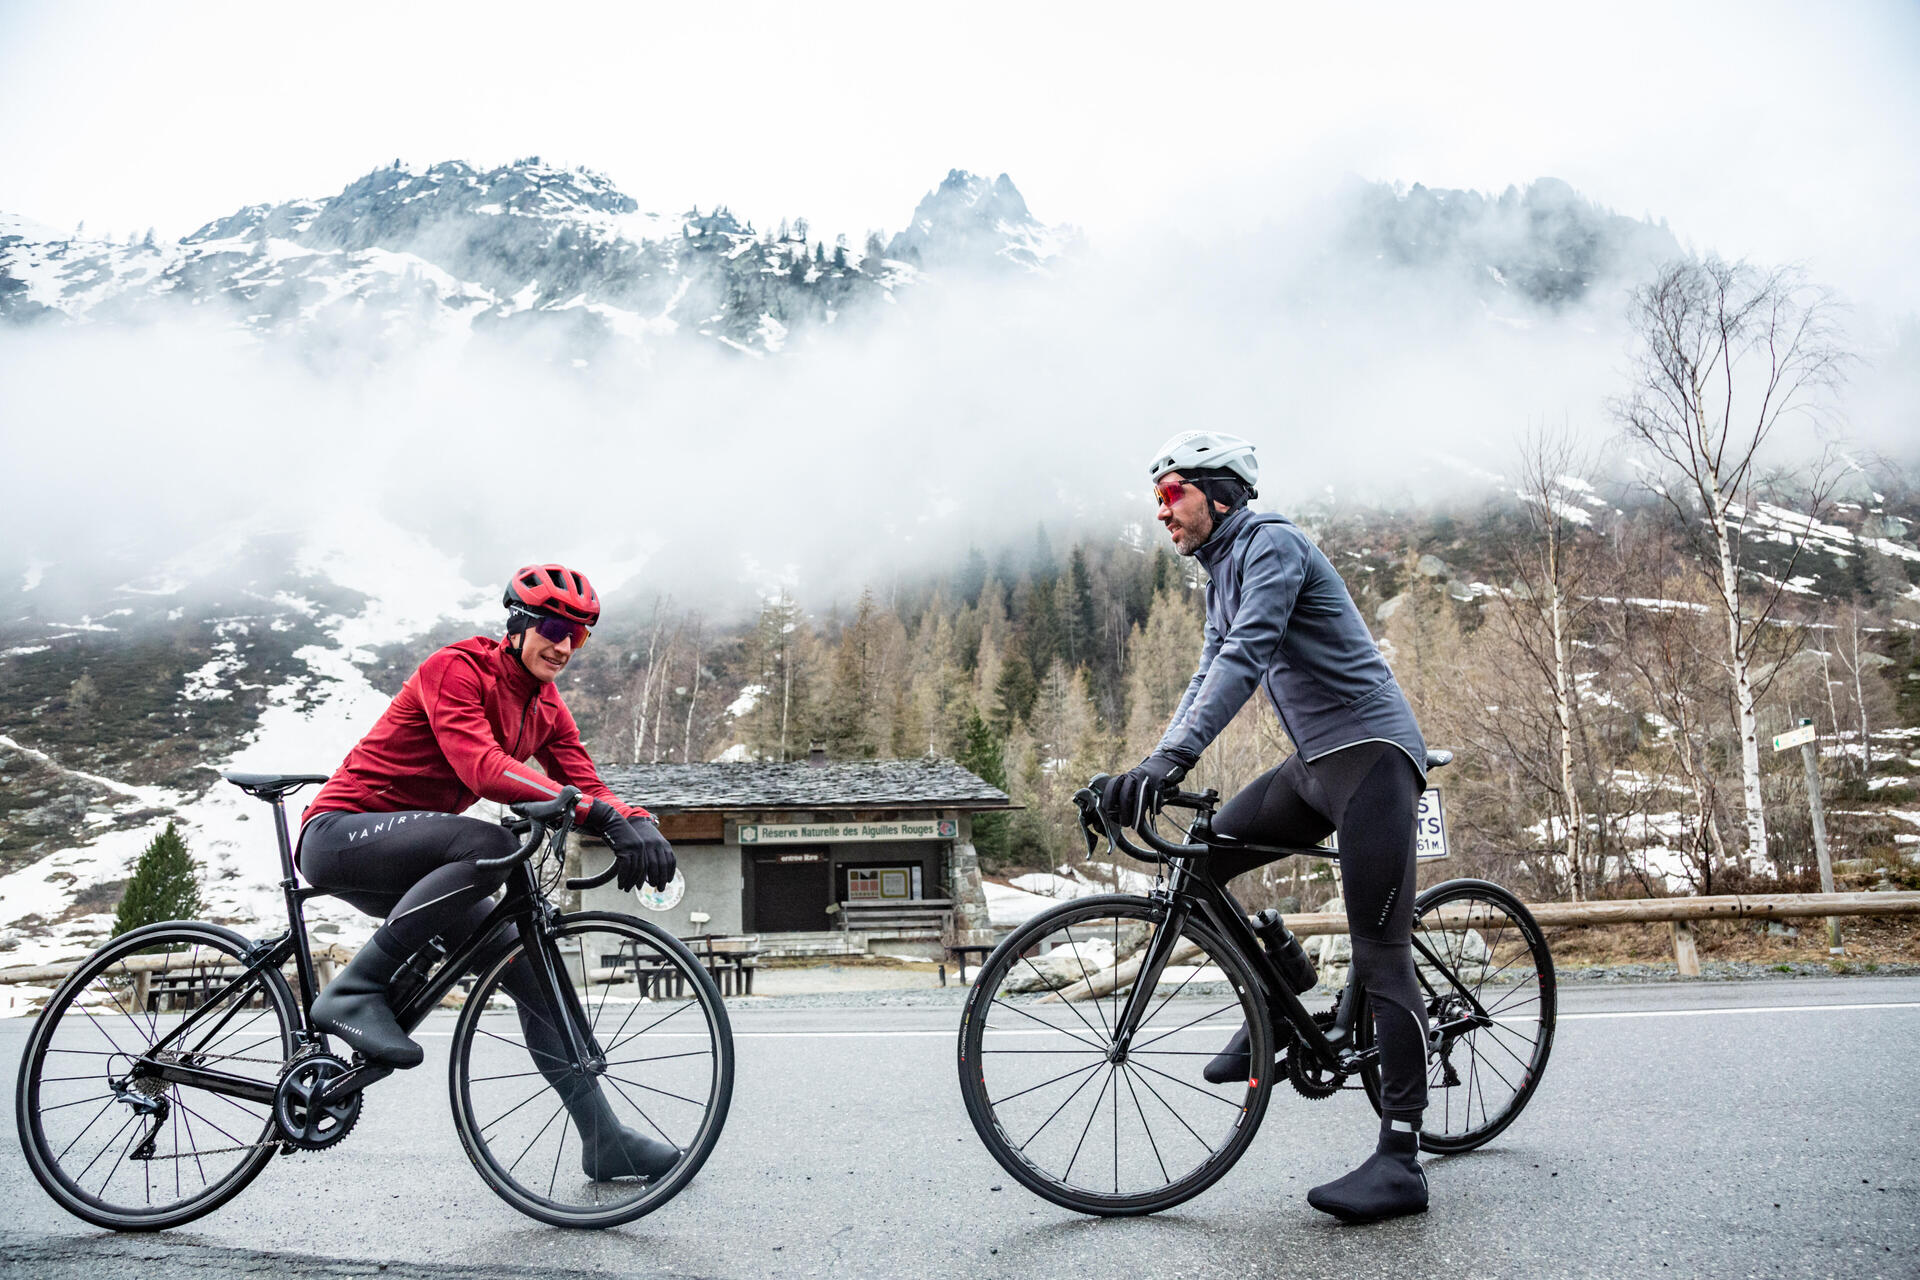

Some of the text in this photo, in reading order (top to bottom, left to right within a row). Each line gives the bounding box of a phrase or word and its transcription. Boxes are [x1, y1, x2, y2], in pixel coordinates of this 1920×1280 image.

[1418, 796, 1429, 814] S
[762, 824, 934, 838] Réserve Naturelle des Aiguilles Rouges
[1418, 817, 1440, 835] TS
